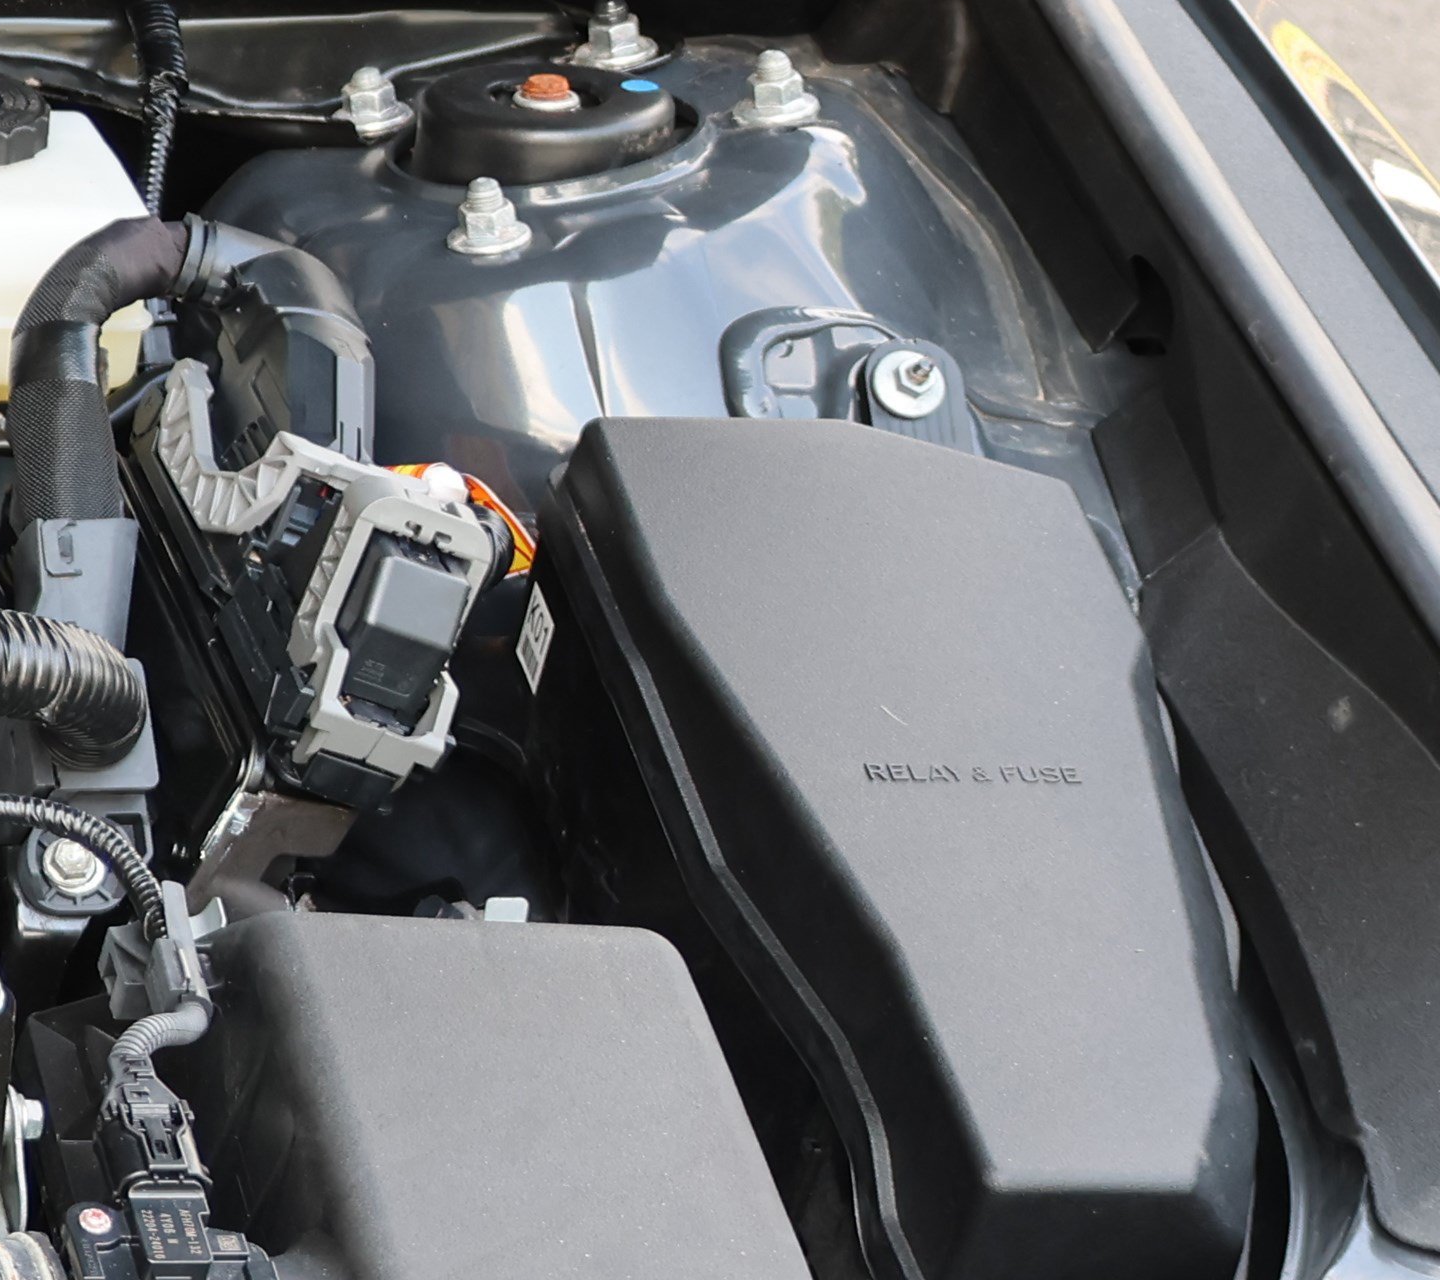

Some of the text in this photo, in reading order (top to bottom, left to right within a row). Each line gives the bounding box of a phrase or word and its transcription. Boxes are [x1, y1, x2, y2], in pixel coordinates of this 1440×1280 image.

[864, 762, 1083, 787] RELAY & FUSE
